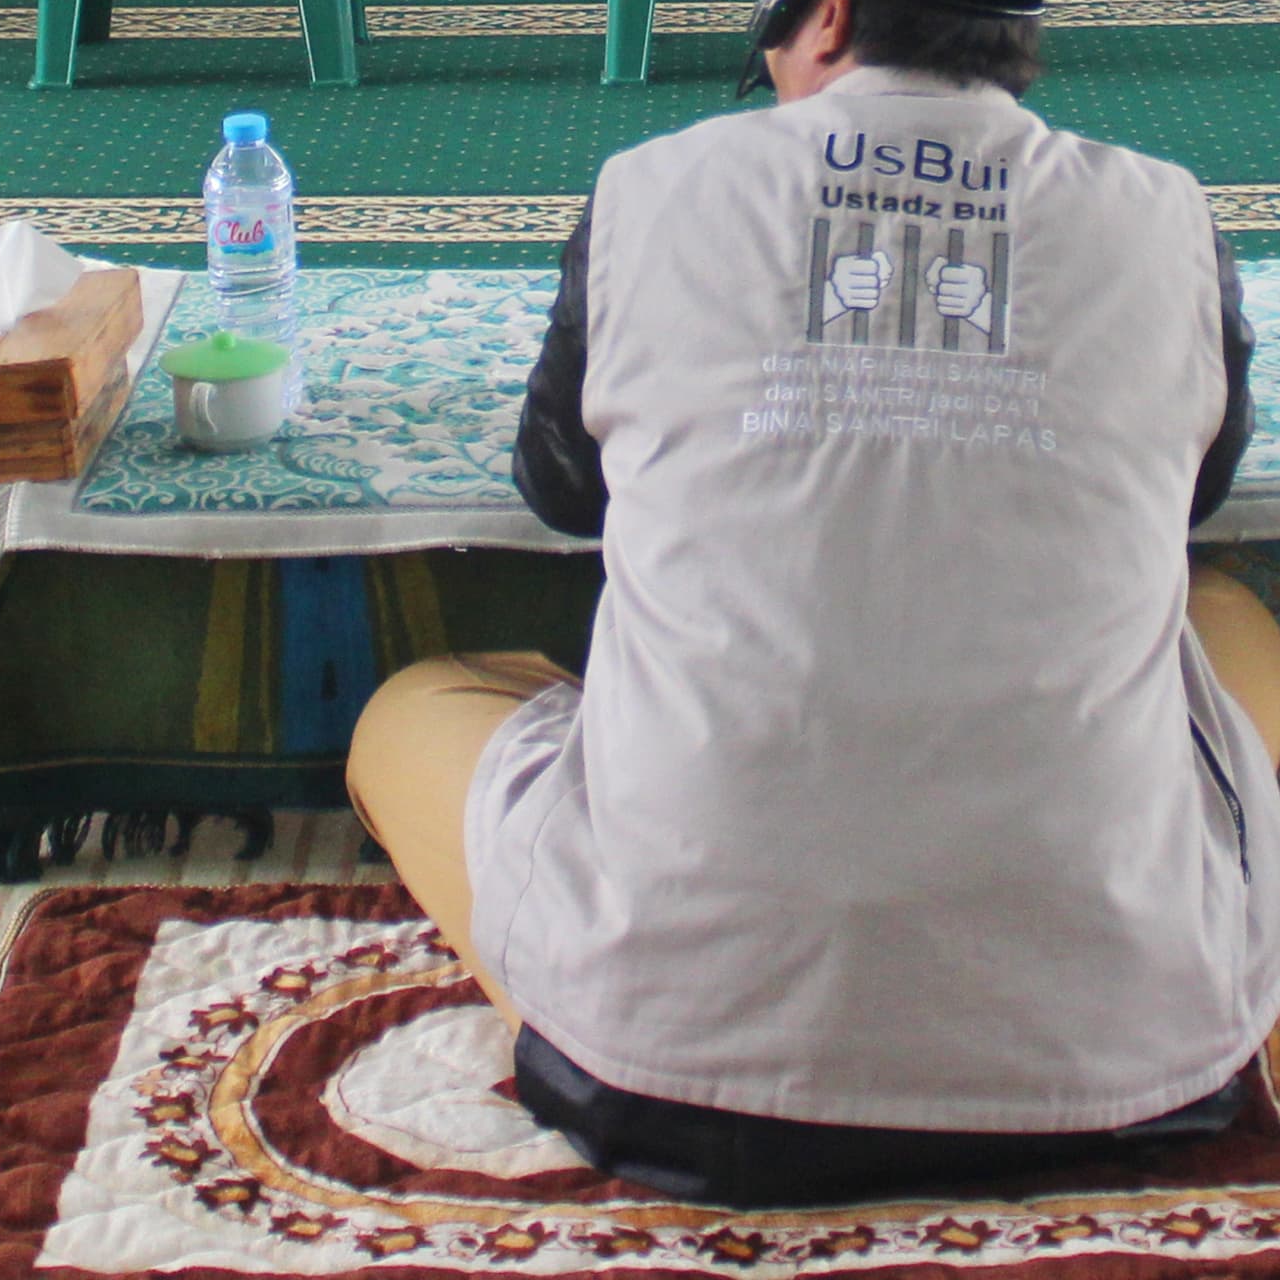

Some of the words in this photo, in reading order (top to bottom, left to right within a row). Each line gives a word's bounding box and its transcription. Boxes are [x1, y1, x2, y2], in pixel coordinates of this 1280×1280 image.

[825, 132, 1008, 192] UsBui
[822, 186, 943, 219] Ustadz
[953, 201, 1007, 222] Bui
[214, 219, 265, 246] Club
[762, 354, 811, 372] dari
[821, 357, 884, 377] NAPI
[947, 363, 1048, 392] SANTRI
[765, 383, 813, 401] dari
[823, 383, 920, 407] SANTRI
[928, 393, 975, 413] jadi
[742, 411, 810, 433] BINA
[826, 412, 939, 439] SANTRI
[951, 421, 1057, 451] LAPAS
